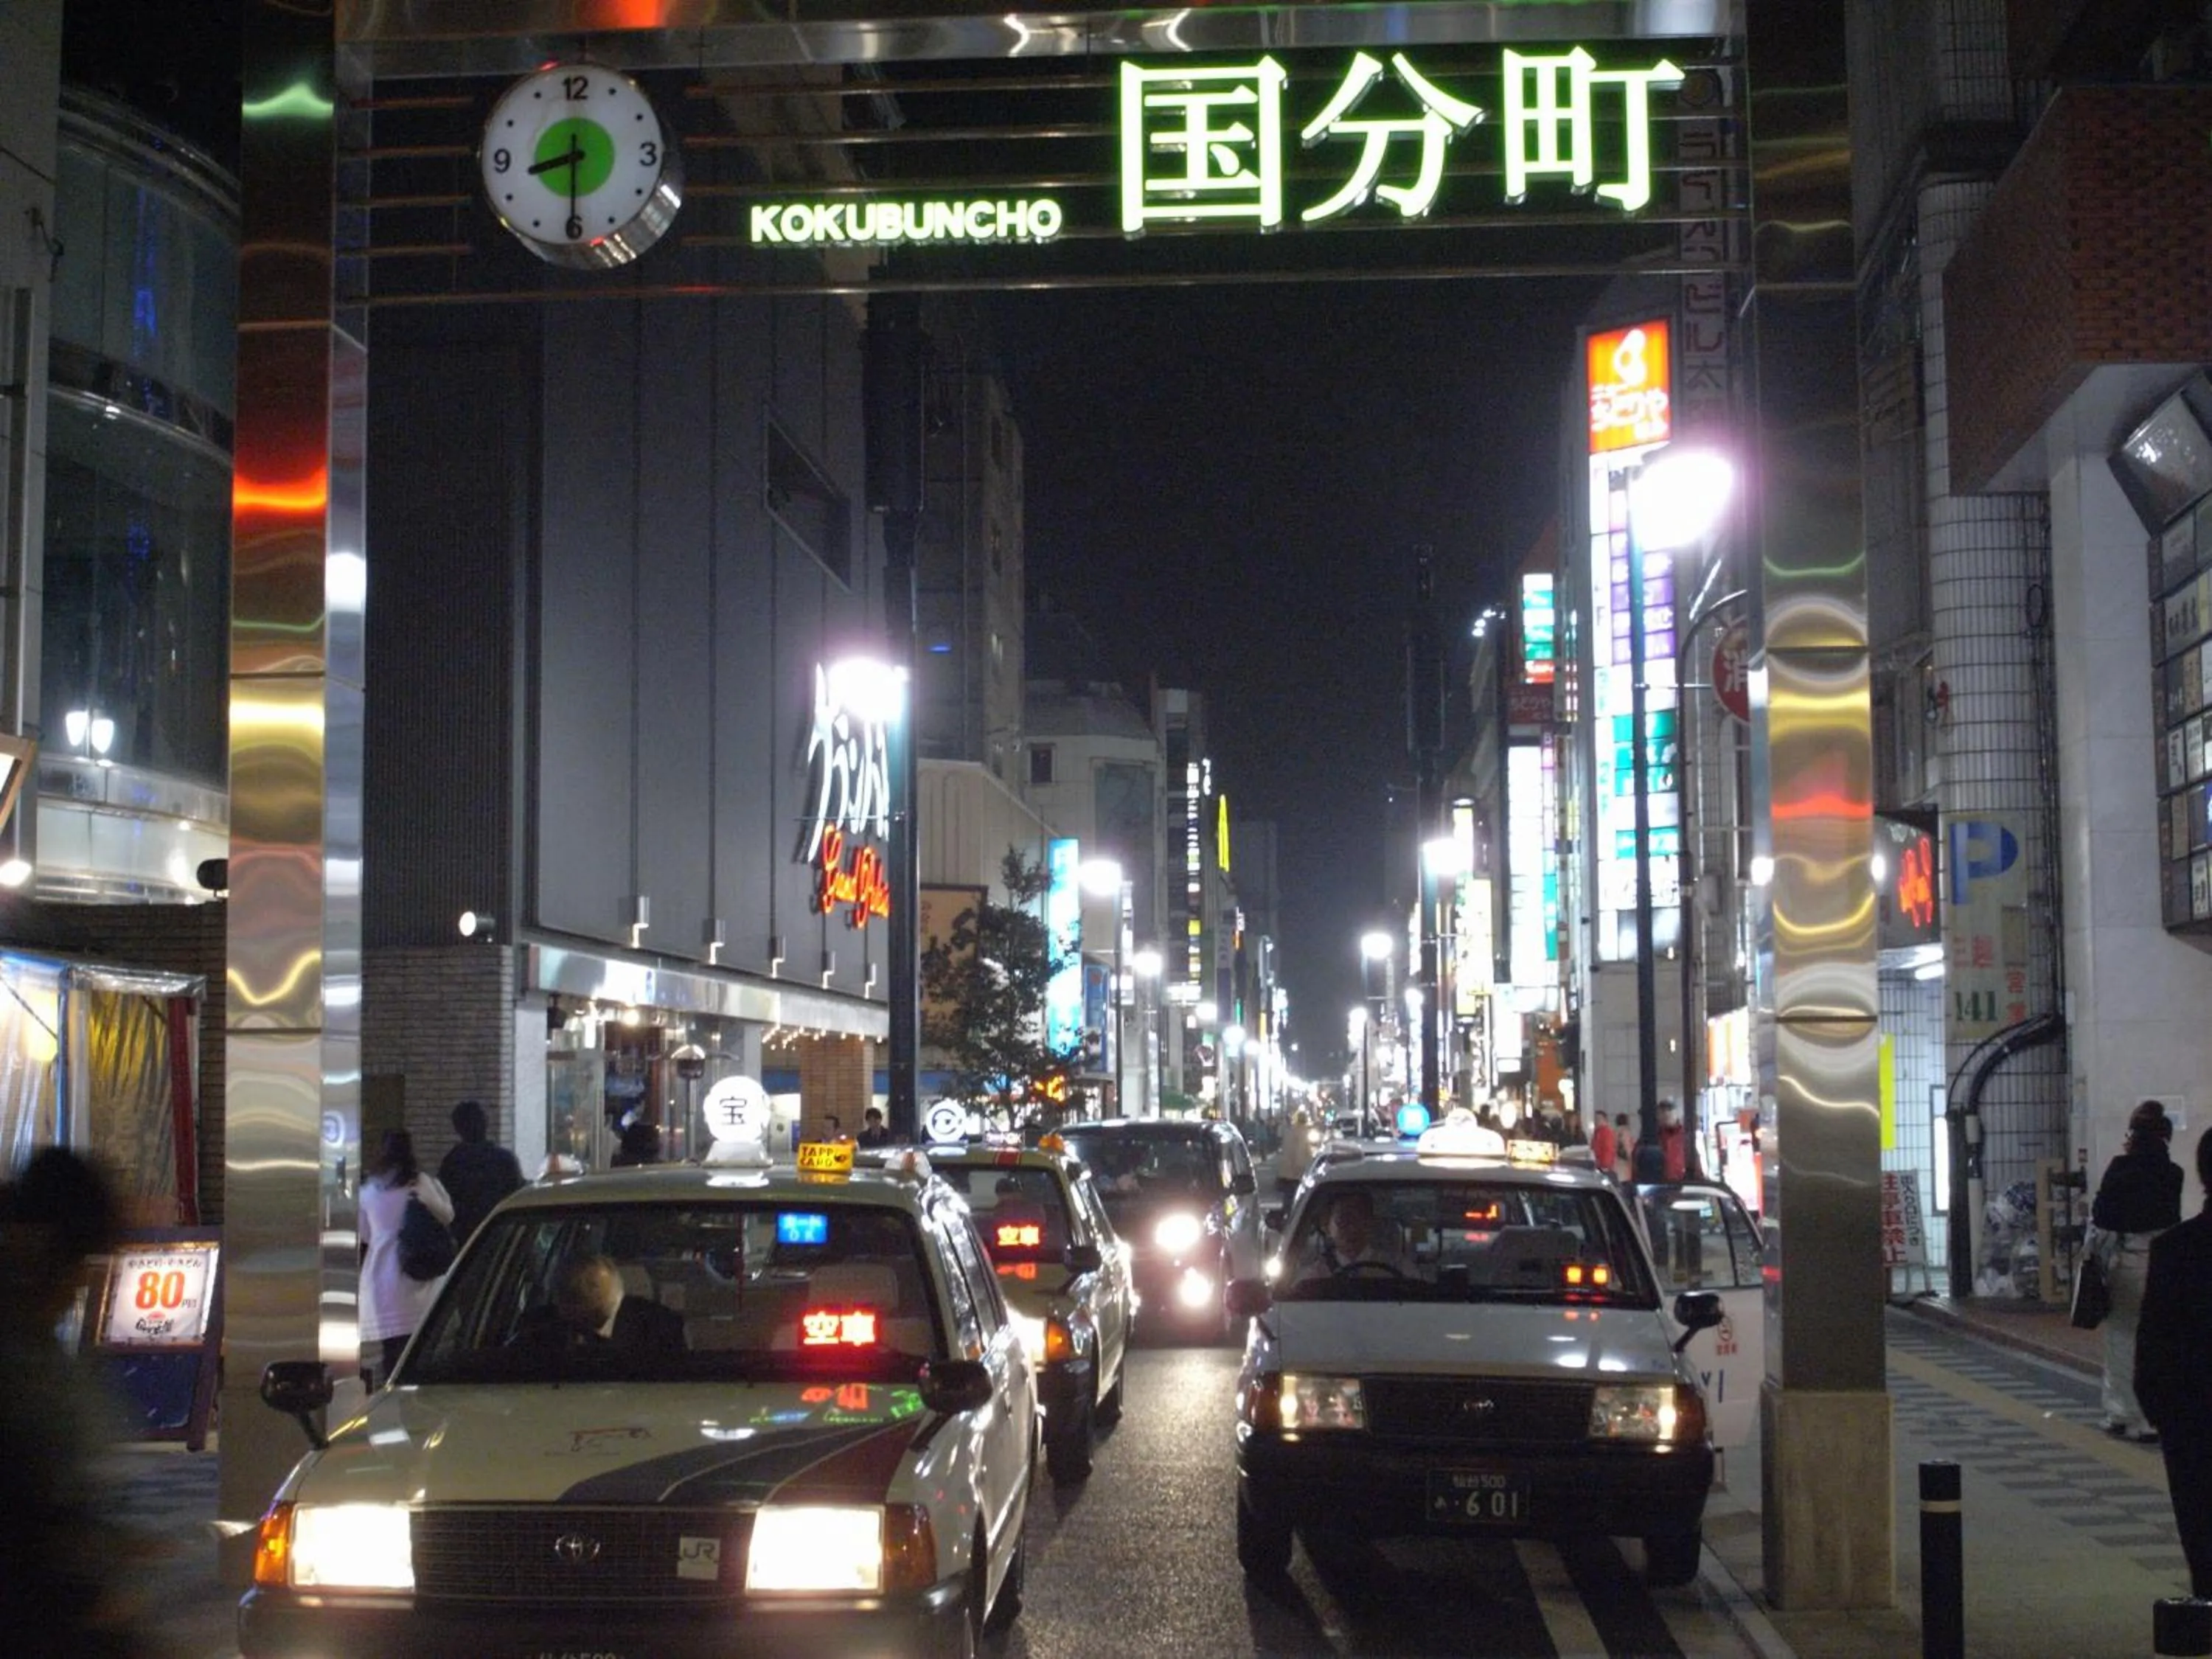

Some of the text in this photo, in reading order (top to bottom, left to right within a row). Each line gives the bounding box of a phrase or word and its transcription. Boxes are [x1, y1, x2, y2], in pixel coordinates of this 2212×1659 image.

[562, 76, 589, 100] 12
[639, 142, 658, 167] 3
[1120, 46, 1686, 233] 国分町
[493, 148, 512, 173] 9
[565, 215, 583, 240] 6
[750, 198, 1064, 245] KOKUBUNCHO
[719, 1096, 747, 1126] 宝
[135, 1270, 186, 1310] 80
[802, 1310, 876, 1347] 空車
